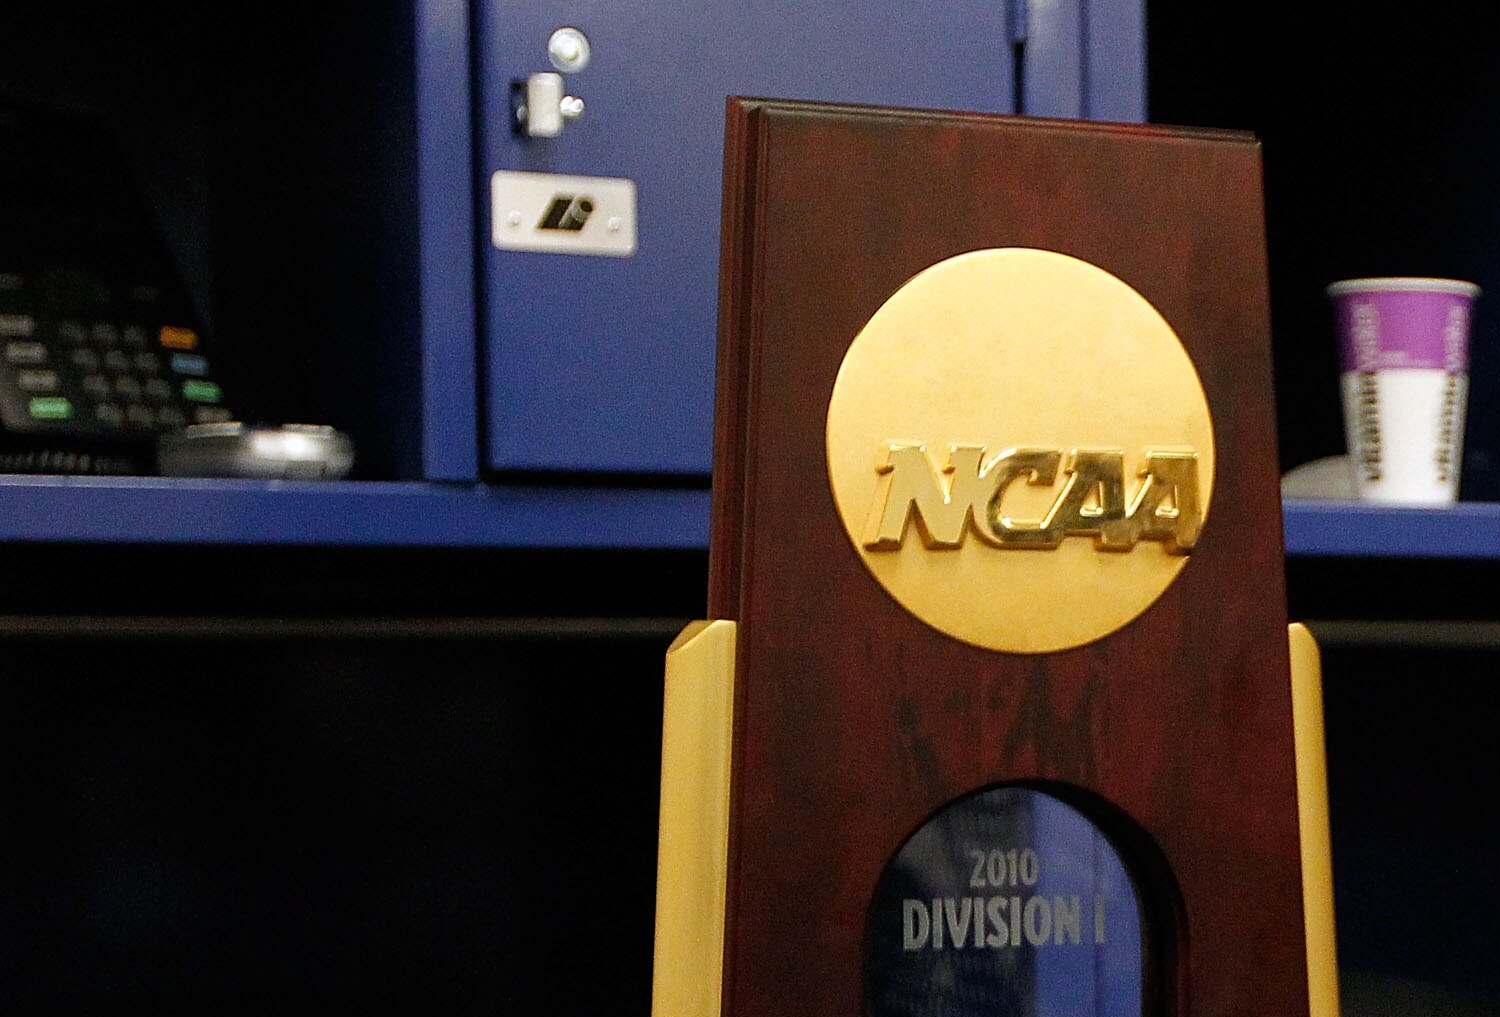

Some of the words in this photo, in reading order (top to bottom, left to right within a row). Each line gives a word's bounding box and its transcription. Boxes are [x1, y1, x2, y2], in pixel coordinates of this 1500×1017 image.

[863, 443, 1201, 554] NCAA
[969, 848, 1039, 888] 2010
[902, 896, 1082, 950] DIVISION
[1093, 897, 1108, 945] I
